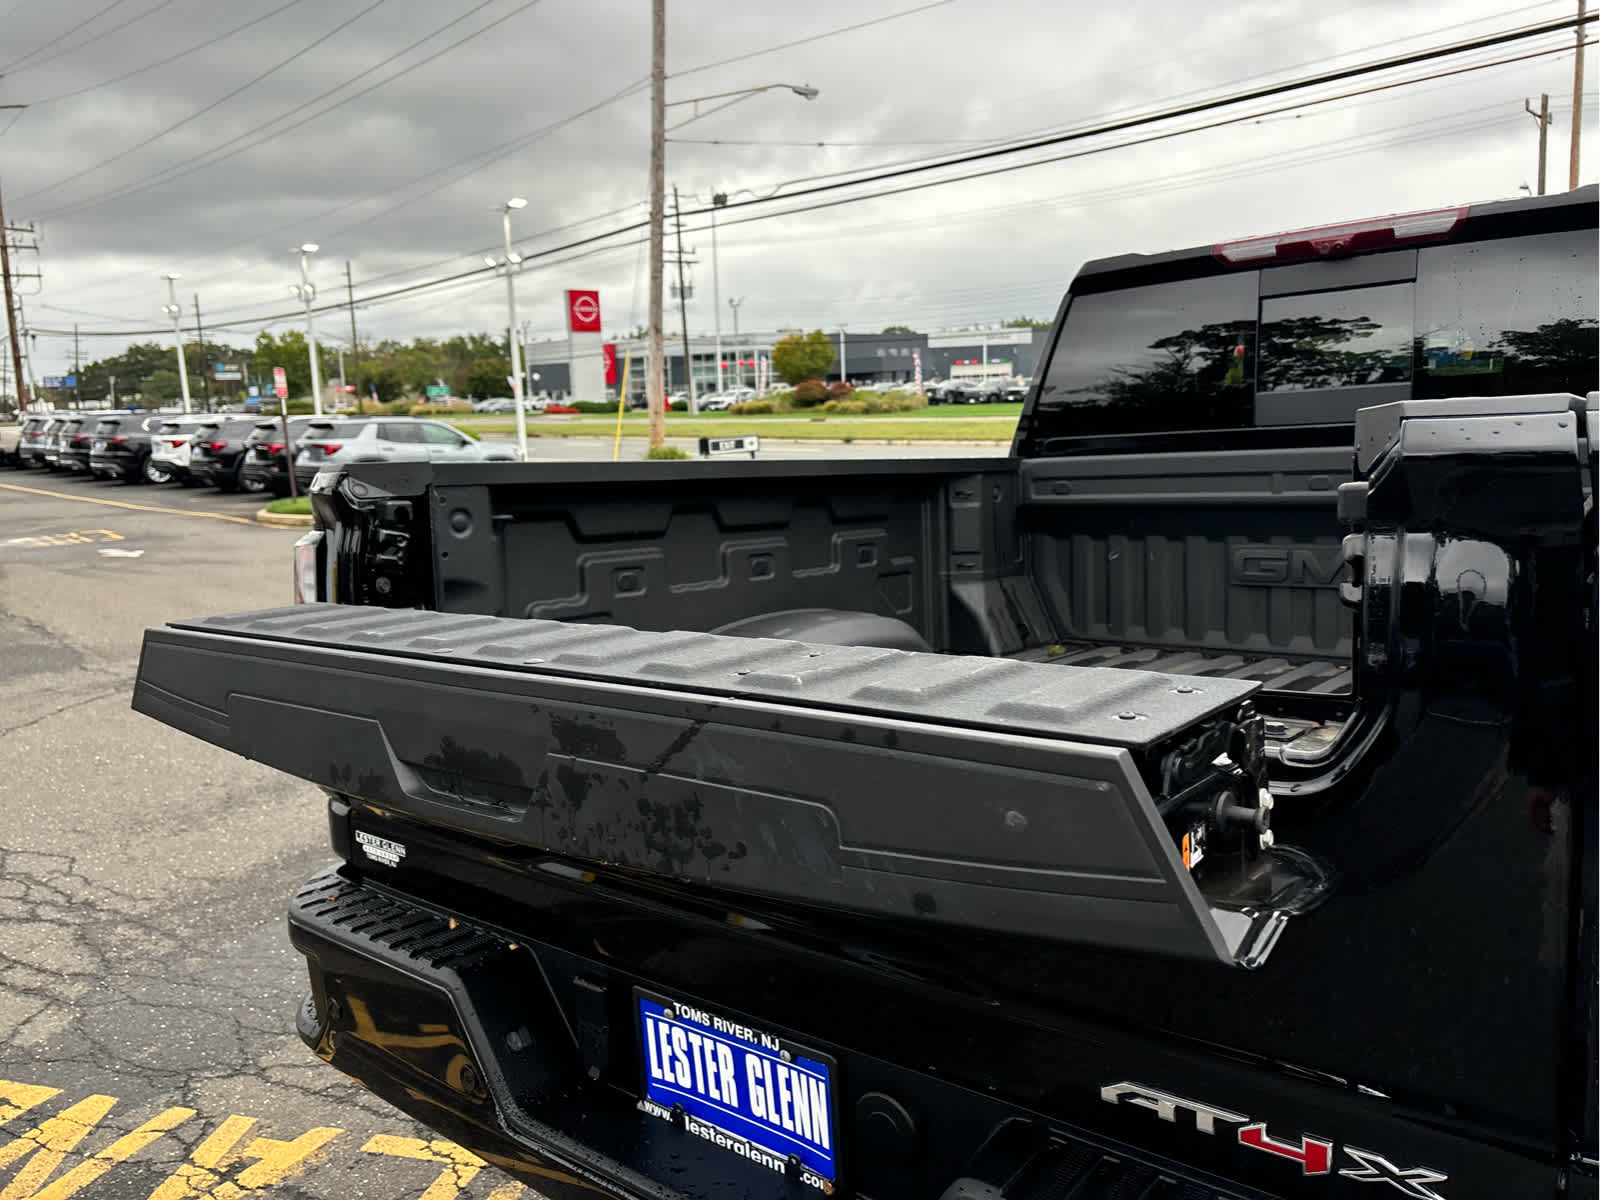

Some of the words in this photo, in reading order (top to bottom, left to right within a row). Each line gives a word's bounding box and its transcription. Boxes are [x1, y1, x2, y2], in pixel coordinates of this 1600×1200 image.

[1232, 549, 1346, 585] GM
[673, 1002, 711, 1026] TOMS
[714, 1017, 758, 1044] RIVER,
[761, 1034, 780, 1052] NJ
[646, 1018, 739, 1108] LESTER
[745, 1053, 831, 1150] GLENN
